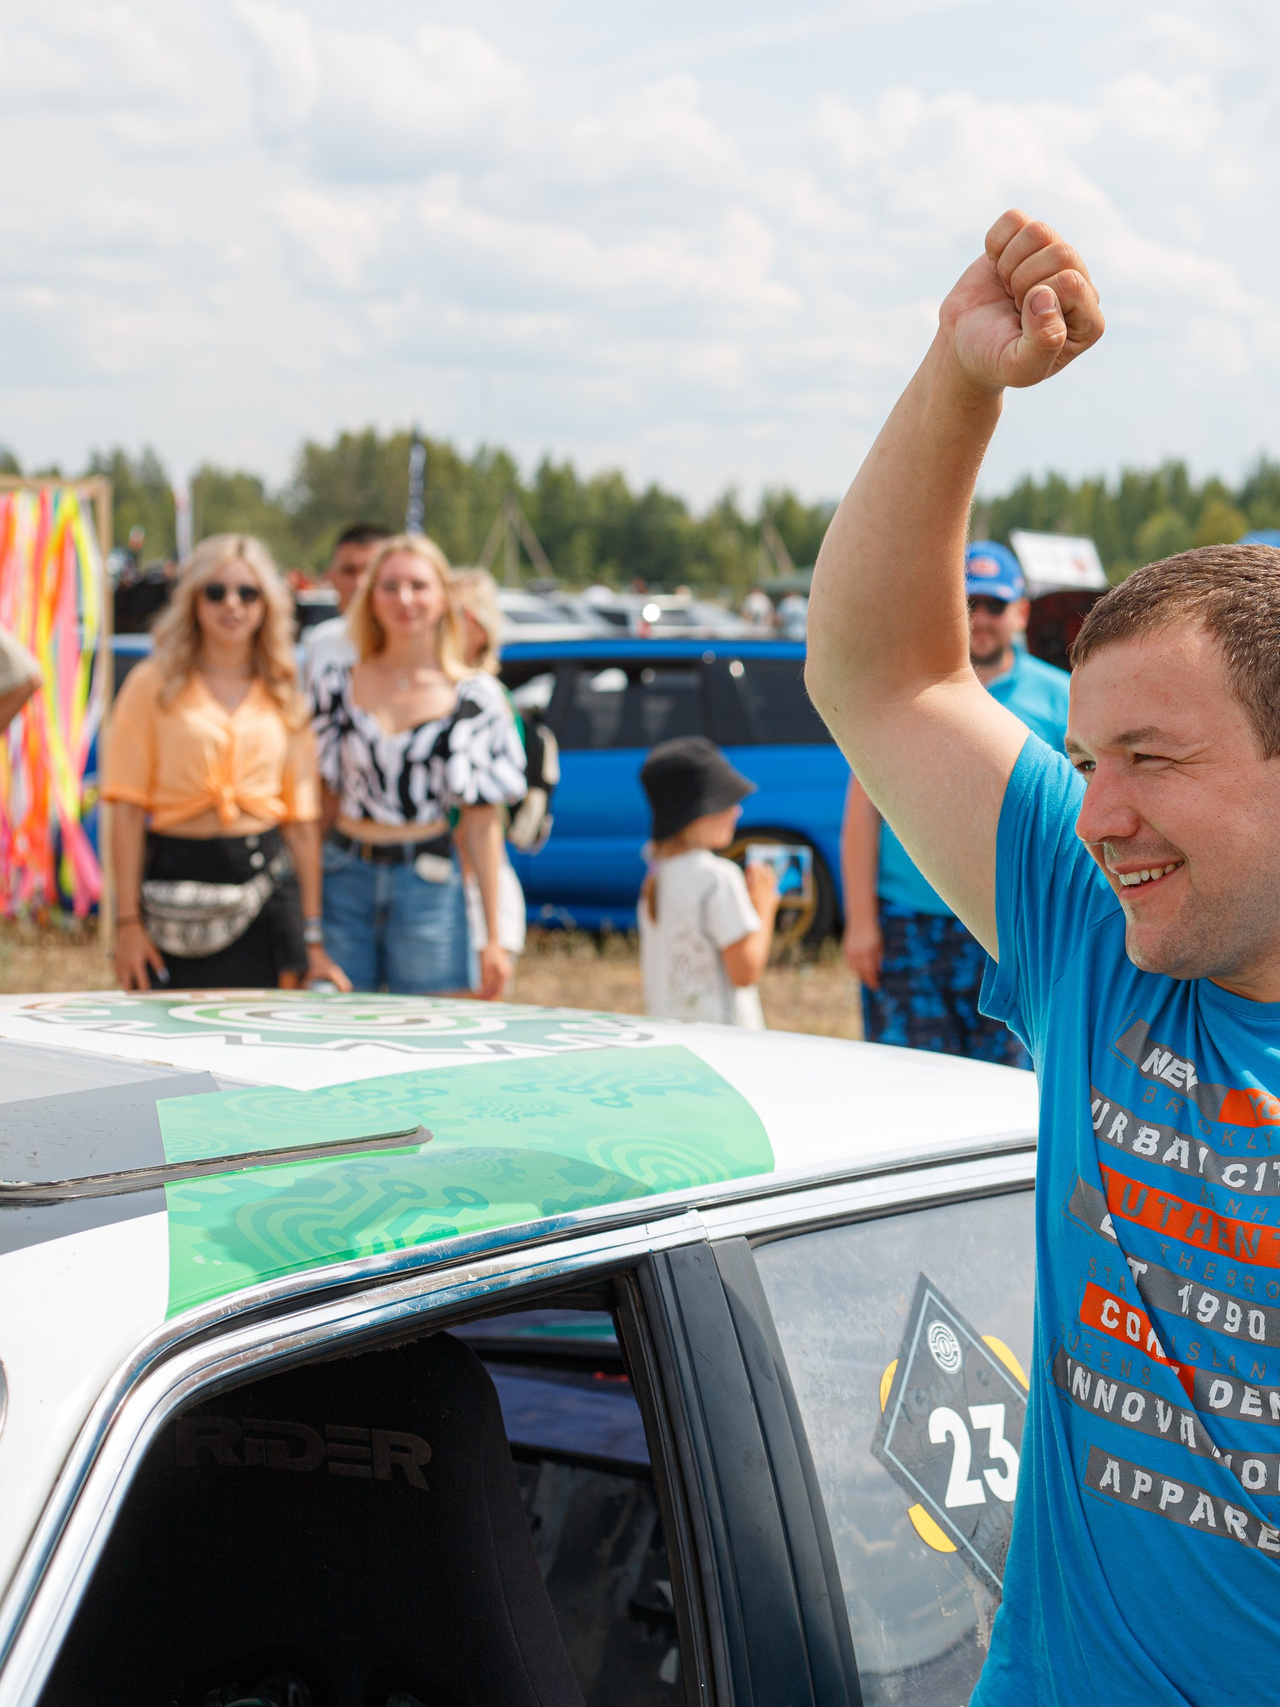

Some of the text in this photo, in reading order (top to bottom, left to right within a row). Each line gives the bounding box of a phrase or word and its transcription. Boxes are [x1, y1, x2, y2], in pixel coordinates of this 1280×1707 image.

[1178, 1281, 1266, 1341] 1990
[177, 1416, 432, 1491] RIDER
[928, 1402, 1020, 1508] 23
